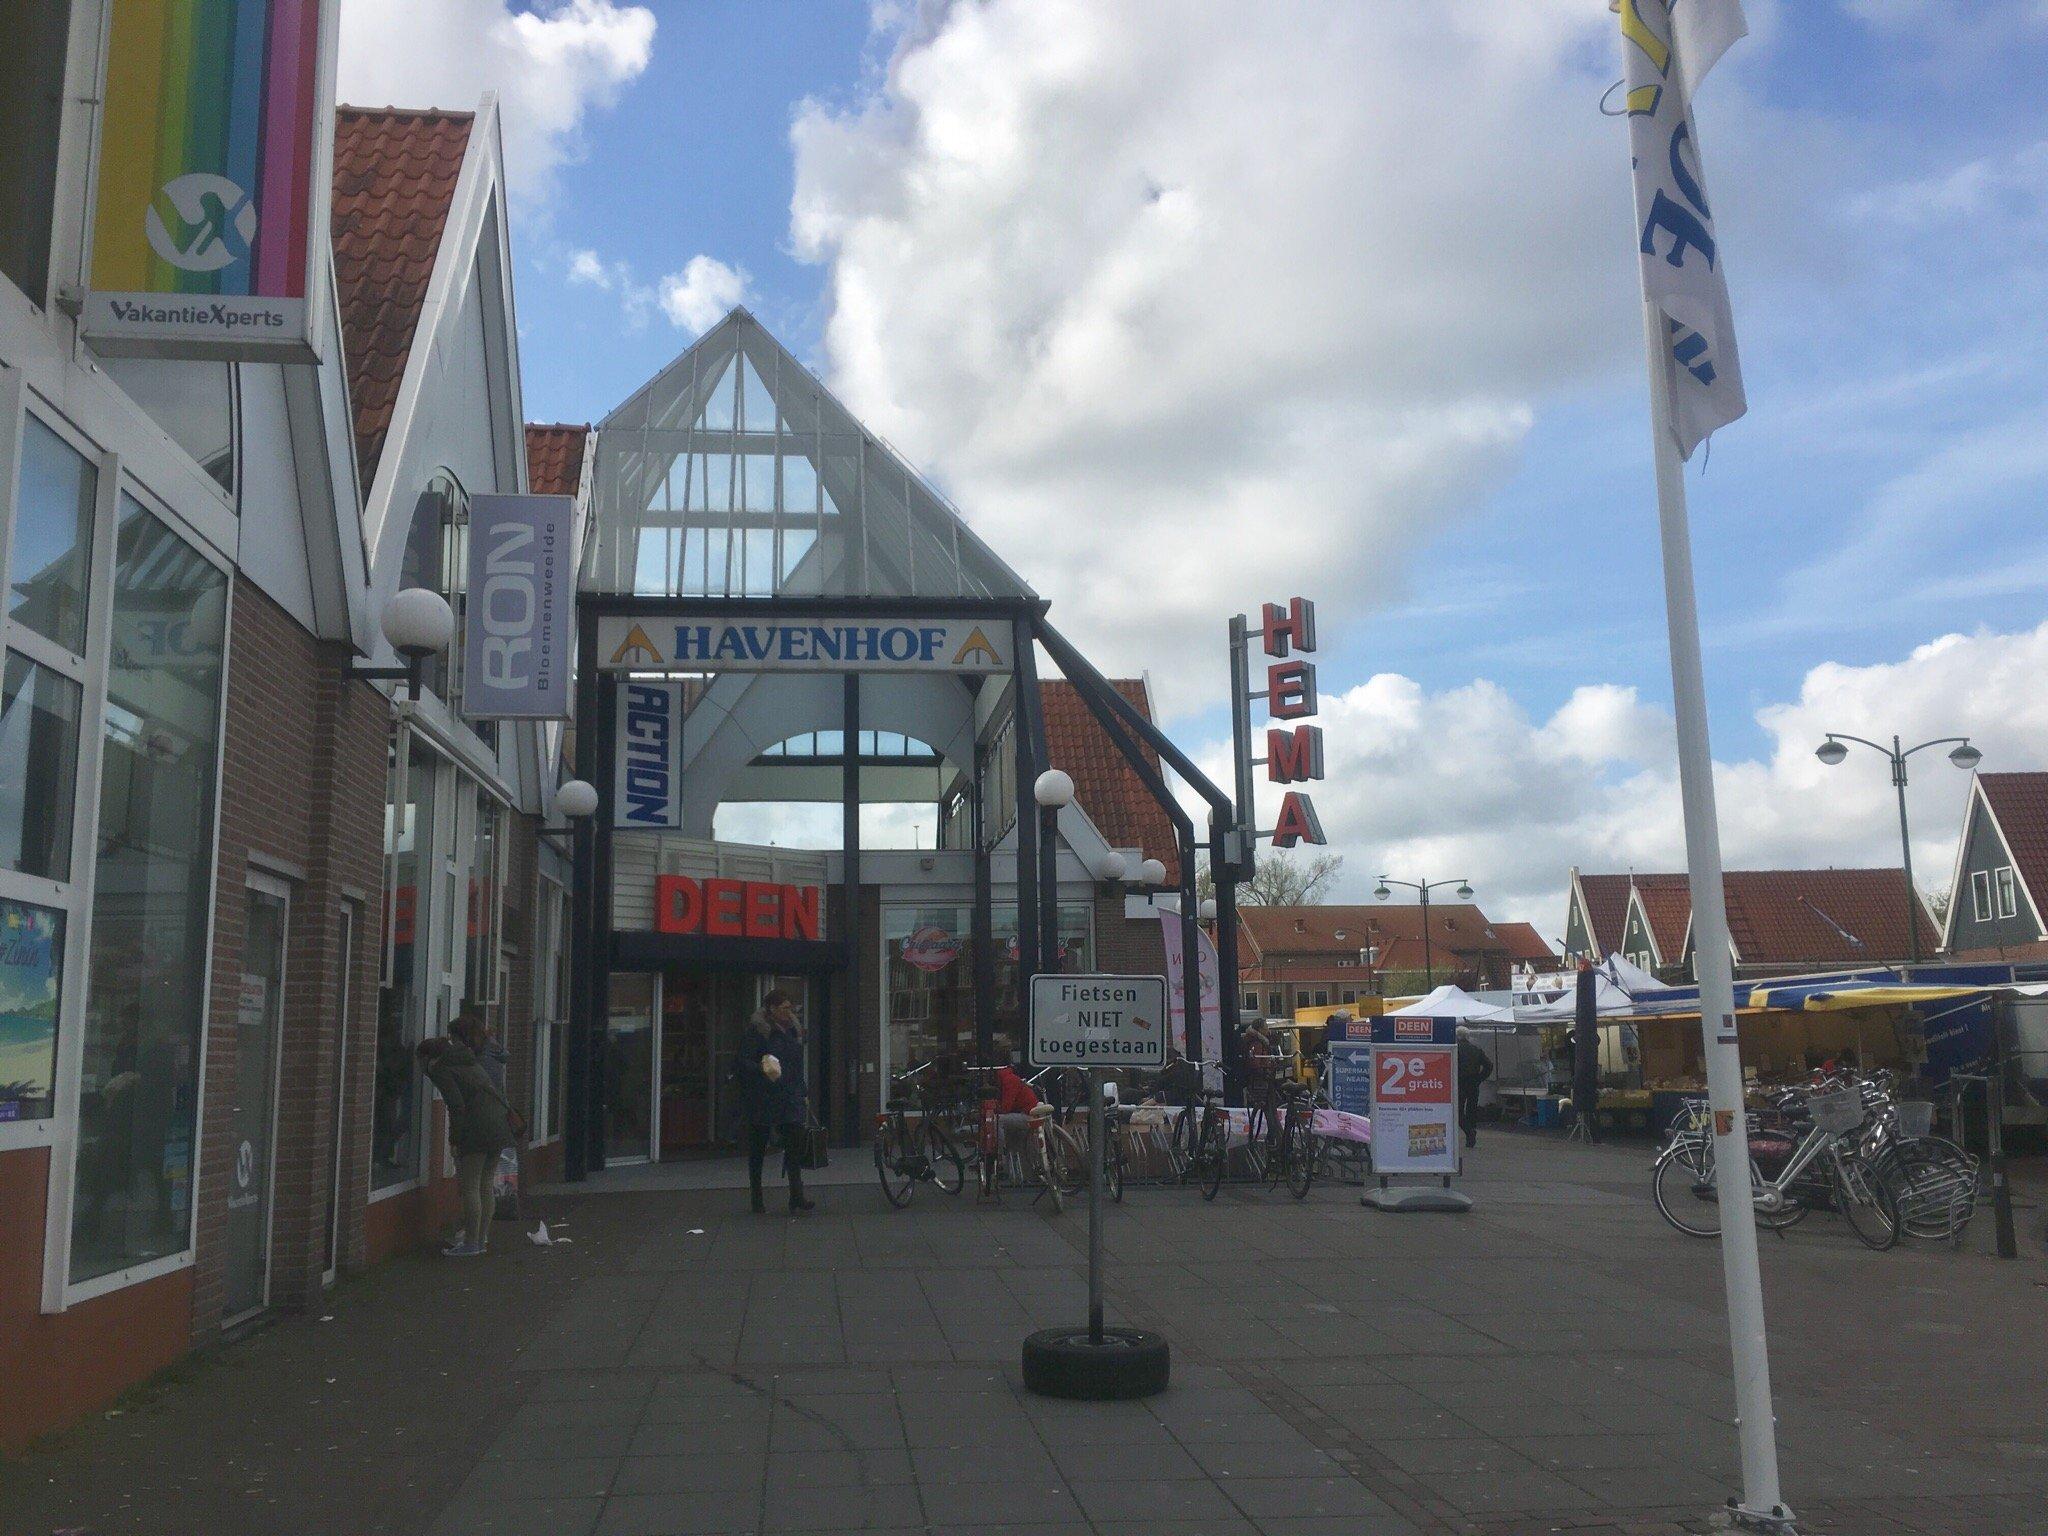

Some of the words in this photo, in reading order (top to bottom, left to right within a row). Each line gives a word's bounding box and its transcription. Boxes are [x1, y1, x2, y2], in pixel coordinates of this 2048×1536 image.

[110, 300, 284, 329] VakantieXperts
[482, 521, 535, 690] RON
[537, 522, 556, 691] Bloemenweelde
[674, 625, 947, 661] HAVENHOF
[1262, 596, 1327, 848] HEMA
[626, 685, 670, 825] ACTION
[655, 874, 820, 941] DEEN
[1061, 984, 1137, 1002] Fietsen
[1078, 1011, 1123, 1028] NIET
[1397, 1021, 1430, 1032] DEEN
[1040, 1037, 1157, 1058] toegestaan
[1408, 1078, 1444, 1092] gratis
